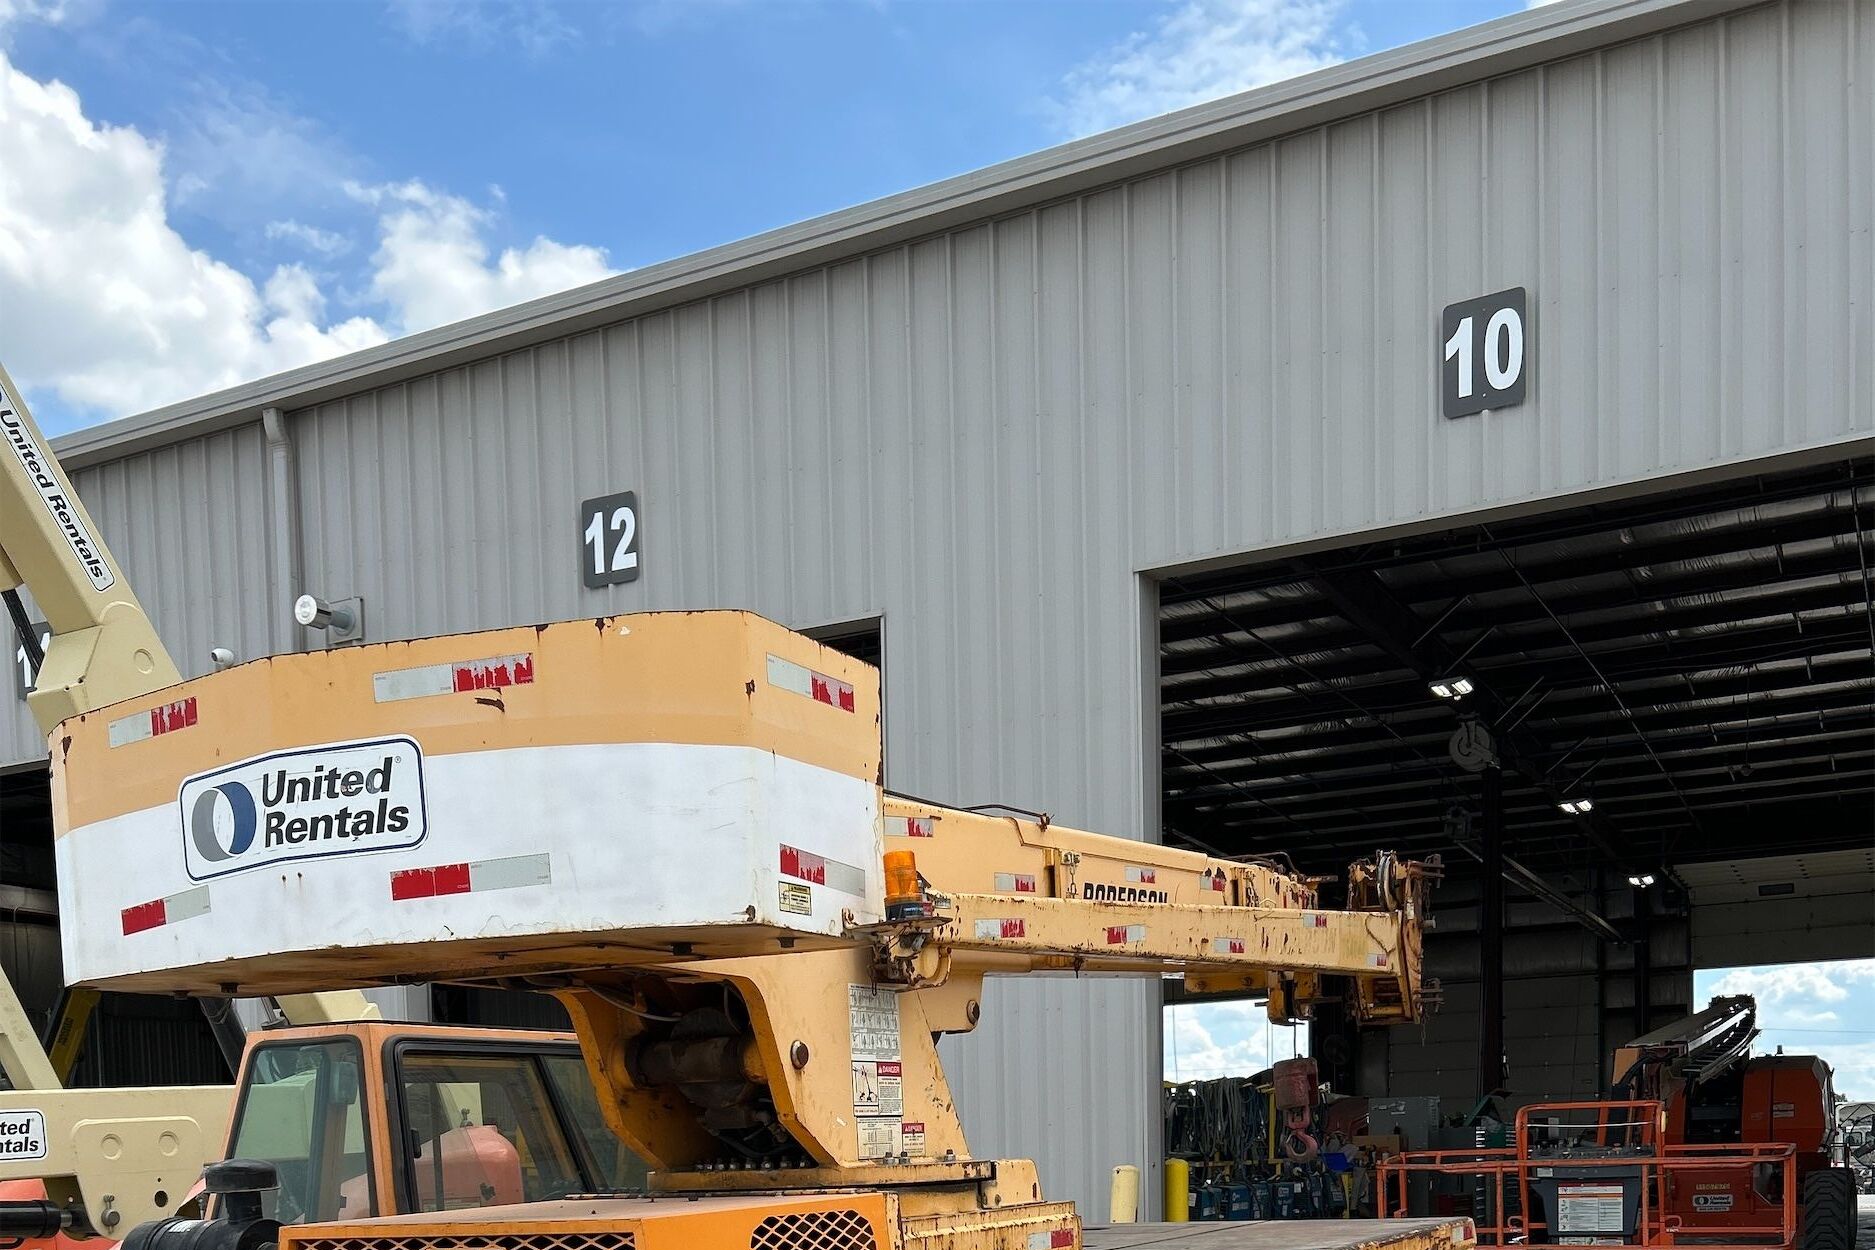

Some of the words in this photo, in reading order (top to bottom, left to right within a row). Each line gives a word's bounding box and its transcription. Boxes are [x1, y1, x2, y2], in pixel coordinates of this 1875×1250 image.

[1445, 307, 1523, 398] 10
[1, 410, 54, 489] United
[48, 494, 104, 578] Rentals
[585, 506, 637, 574] 12
[263, 757, 393, 808] United
[265, 798, 409, 848] Rentals
